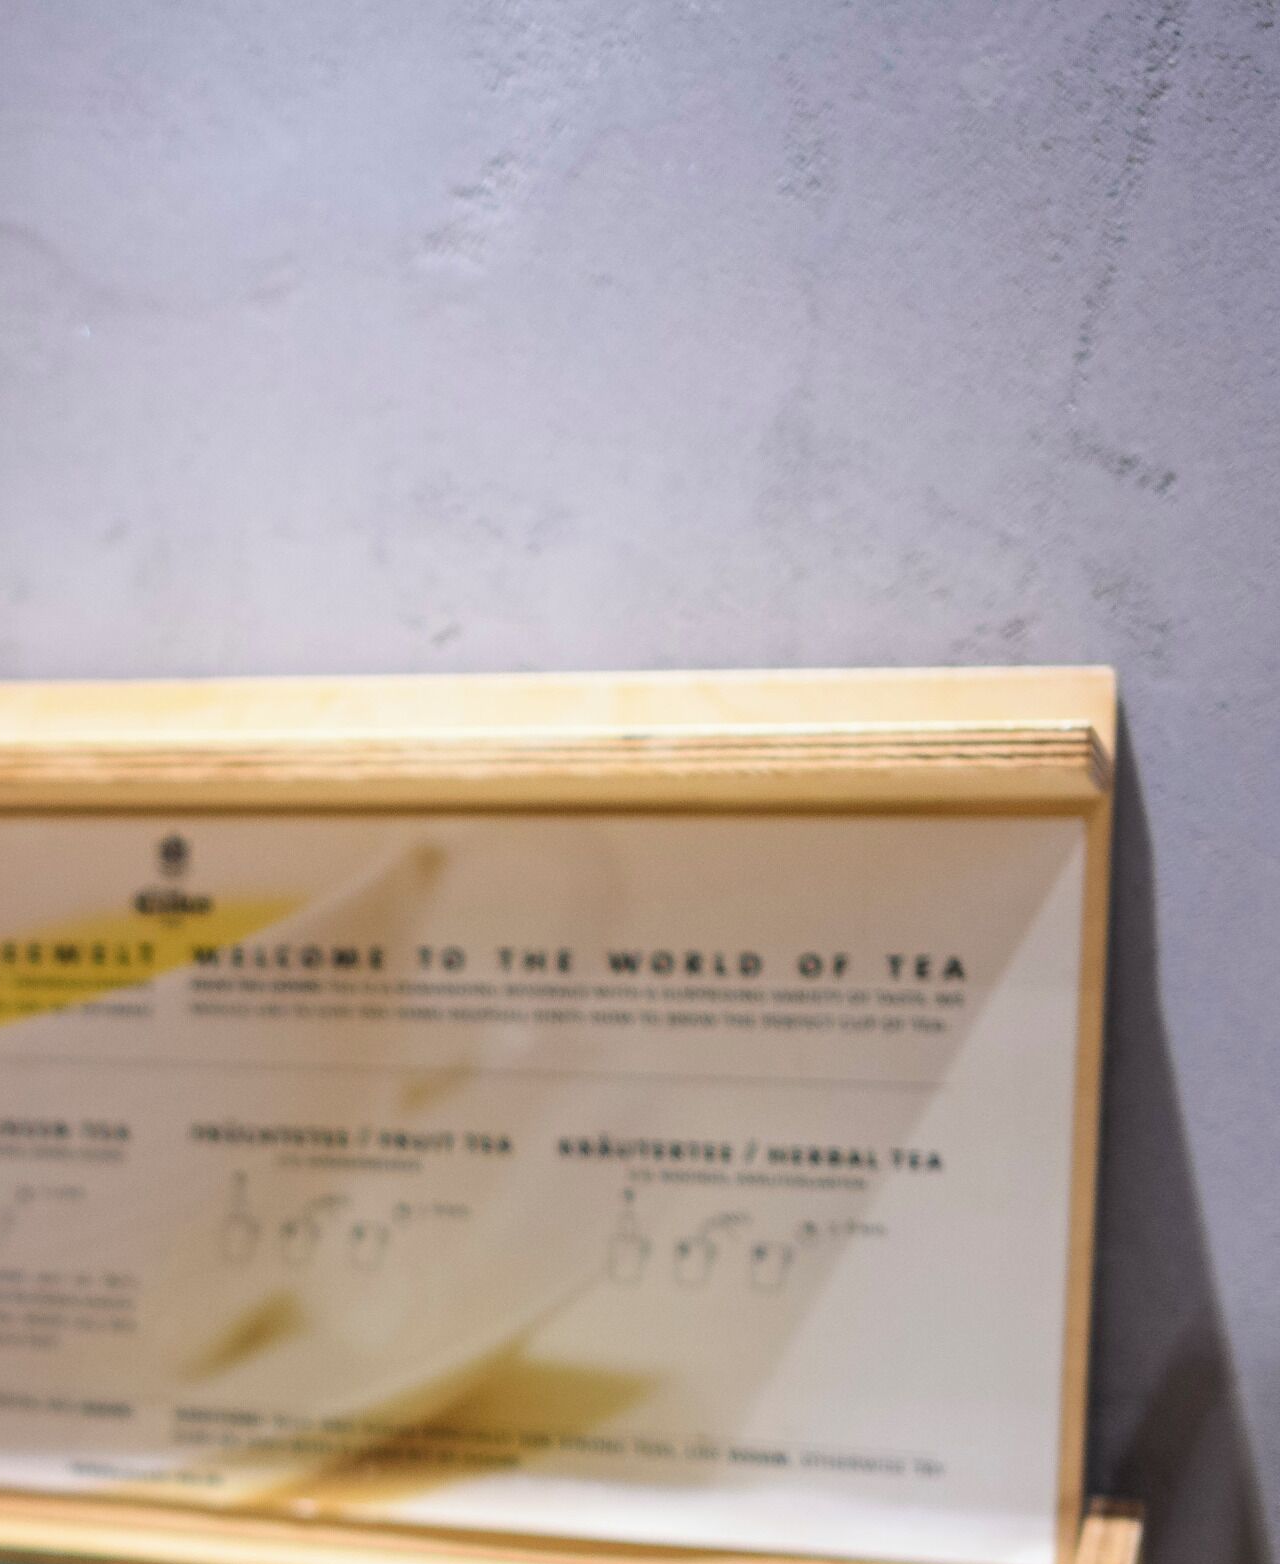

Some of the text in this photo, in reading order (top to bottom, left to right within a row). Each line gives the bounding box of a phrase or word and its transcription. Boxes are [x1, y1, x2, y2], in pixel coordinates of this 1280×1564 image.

[192, 944, 966, 982] WELCOME TO THE WORLD OF TEA
[465, 1130, 514, 1157] TEA
[768, 1146, 878, 1171] HERBAL
[890, 1147, 943, 1171] TEA
